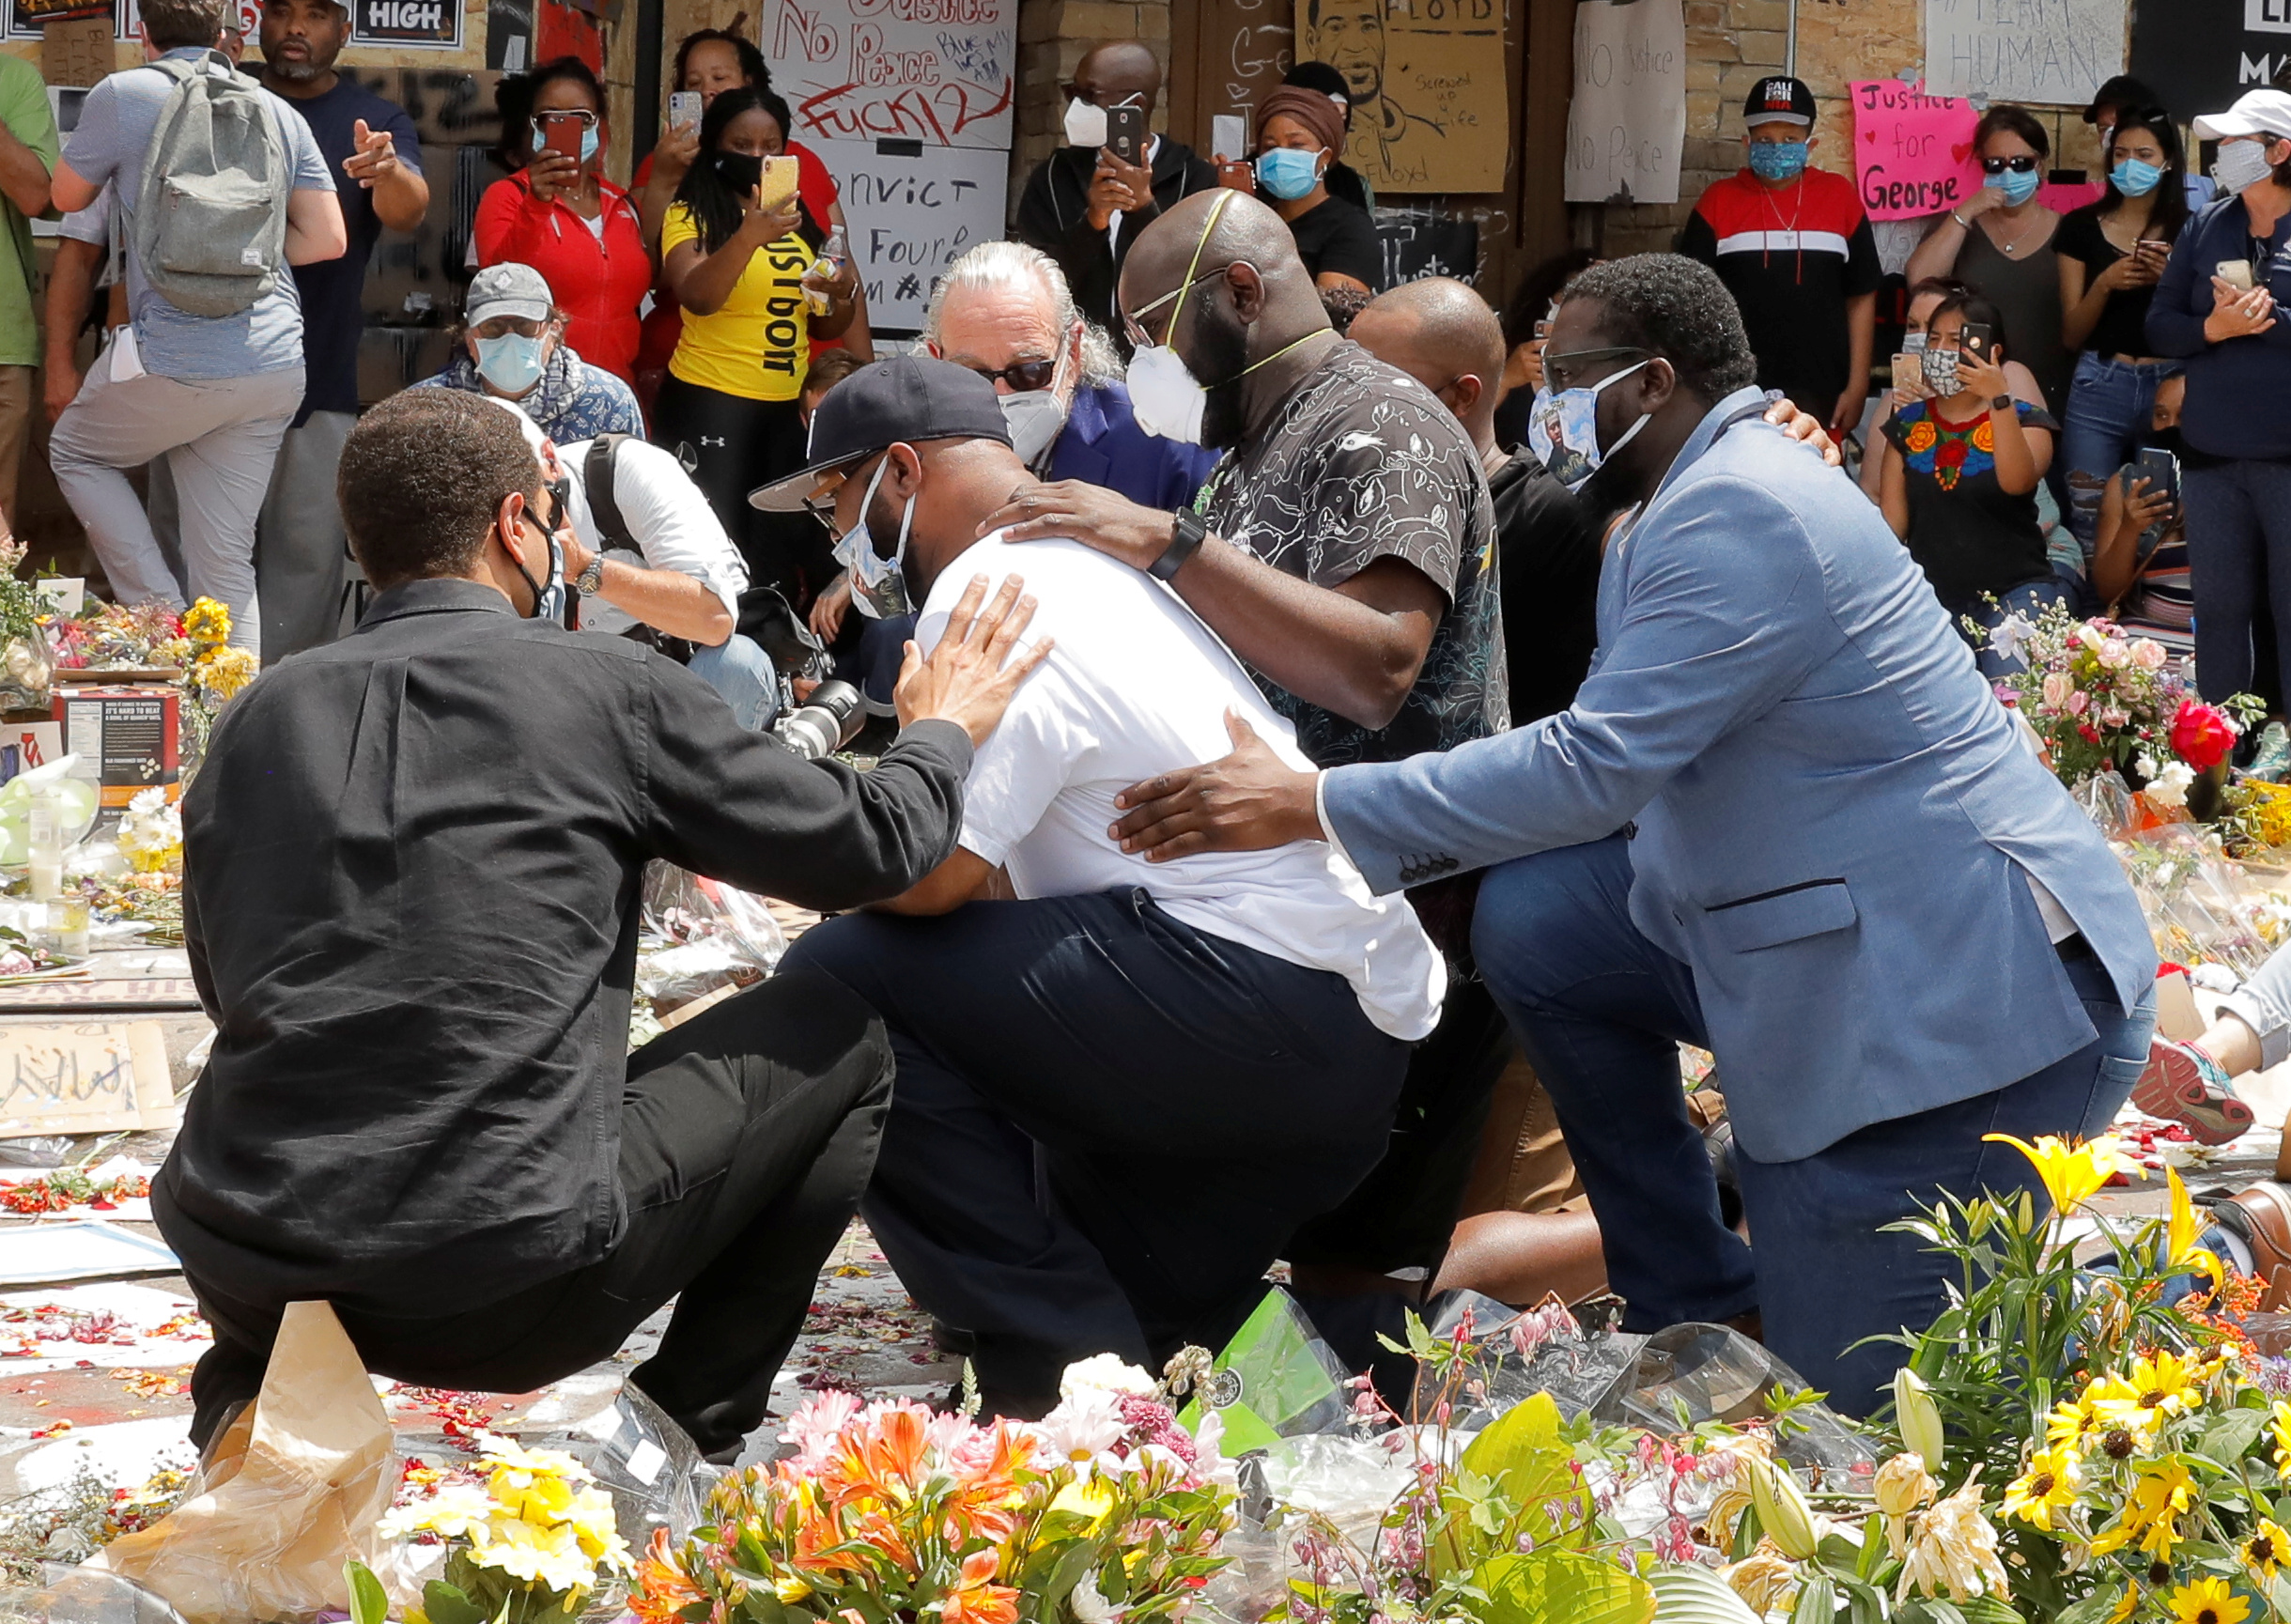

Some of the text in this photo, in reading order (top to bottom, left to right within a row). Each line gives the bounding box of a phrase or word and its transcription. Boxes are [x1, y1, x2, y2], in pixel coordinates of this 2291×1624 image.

[368, 1, 441, 29] HIGH
[773, 0, 839, 62] No
[87, 29, 107, 79] BLAC
[847, 23, 940, 87] Peace
[1950, 33, 2098, 90] HUMAN
[1893, 123, 1936, 158] for
[1864, 165, 1960, 209] George
[763, 237, 808, 294] UST
